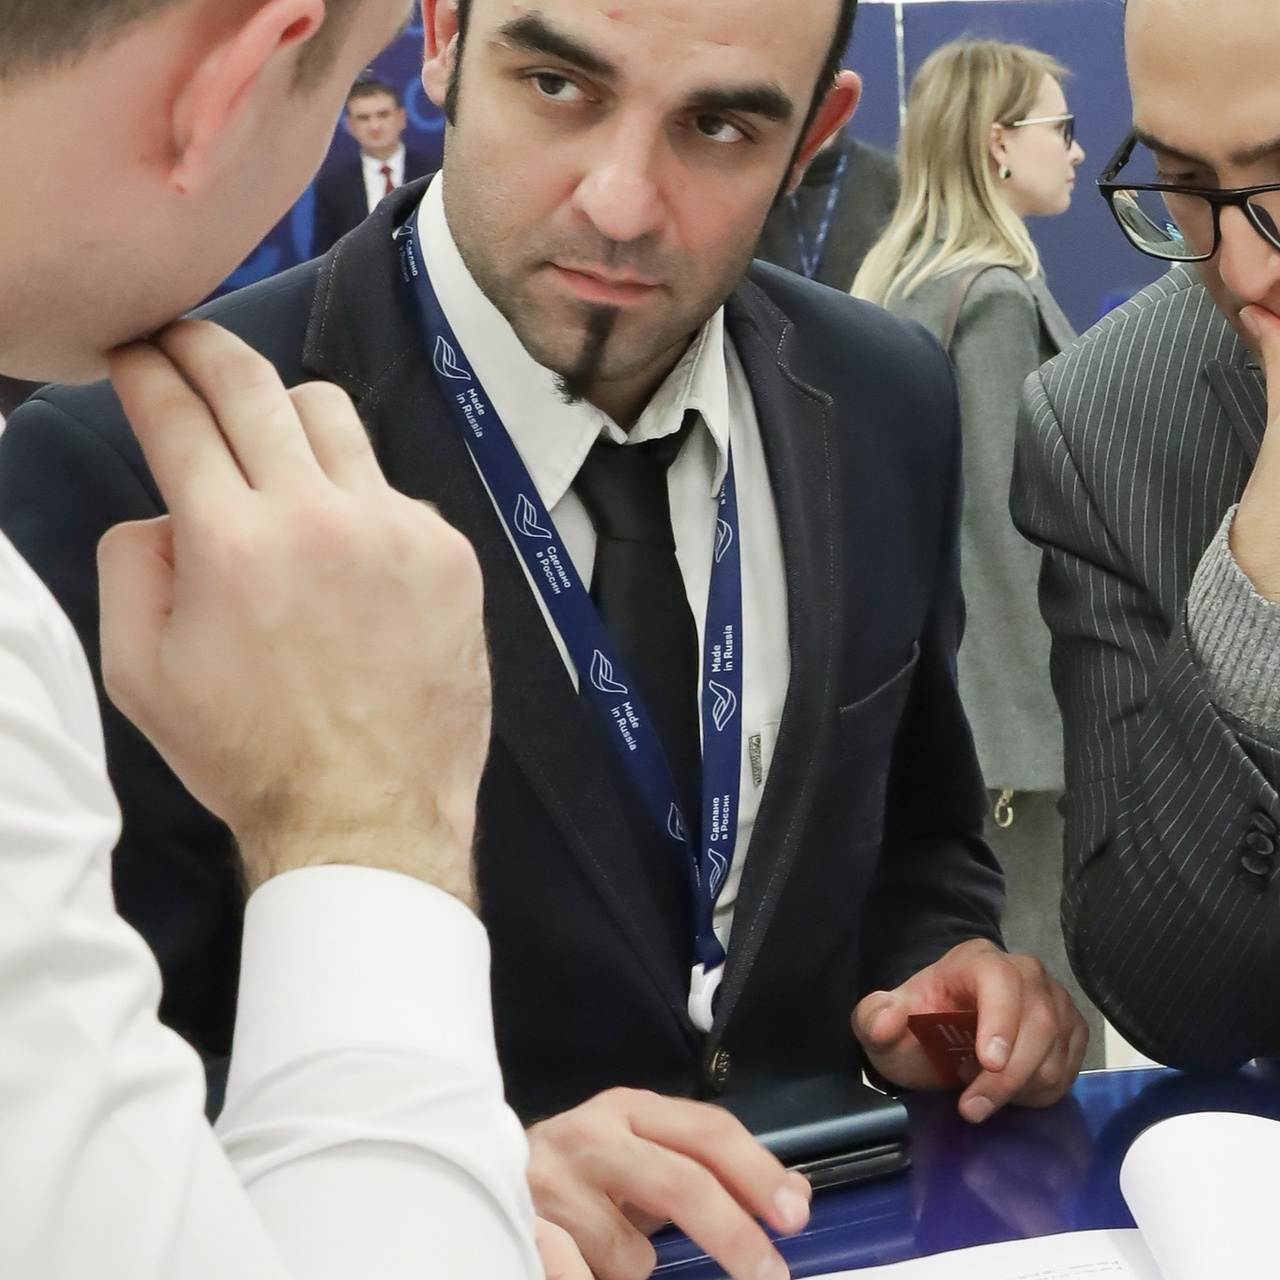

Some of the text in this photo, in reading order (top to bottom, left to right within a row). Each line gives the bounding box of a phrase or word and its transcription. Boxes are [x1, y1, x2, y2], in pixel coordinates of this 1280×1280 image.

[455, 392, 484, 439] in Russia
[466, 387, 485, 416] Made
[540, 558, 561, 595] России
[547, 546, 572, 588] Сделано
[711, 643, 722, 673] Made
[722, 624, 734, 672] in Russia
[610, 706, 637, 751] in Russia
[622, 701, 639, 729] Made
[710, 796, 720, 842] Сделано
[720, 794, 730, 832] России
